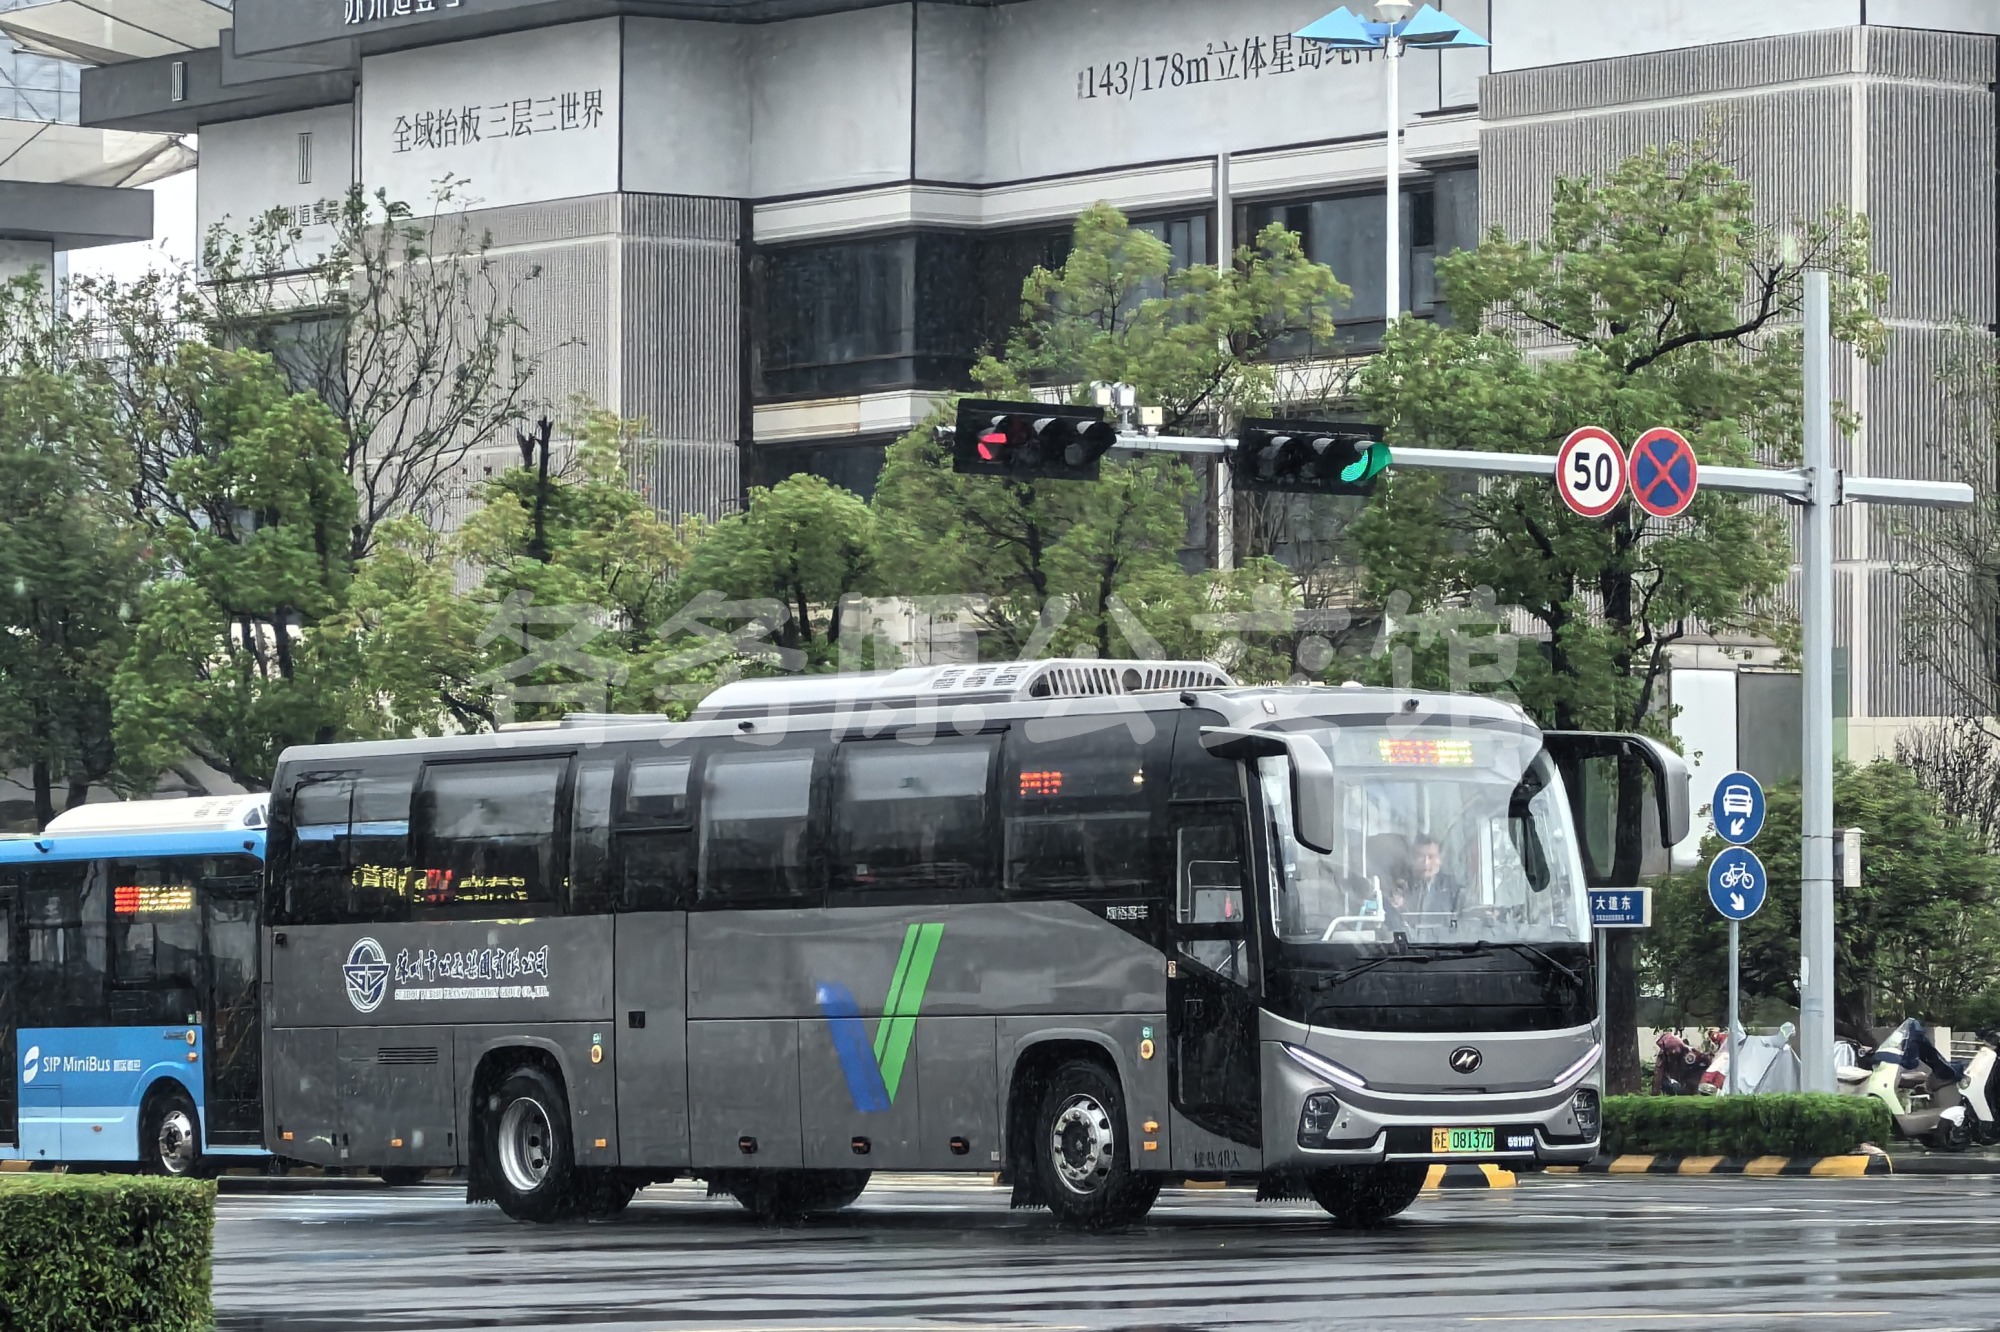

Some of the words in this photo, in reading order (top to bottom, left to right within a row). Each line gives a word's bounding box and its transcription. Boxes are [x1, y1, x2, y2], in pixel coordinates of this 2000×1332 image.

[1573, 452, 1612, 491] 50
[1589, 895, 1631, 910] 大道东
[43, 1056, 61, 1072] SIP
[63, 1056, 110, 1072] MiniBus
